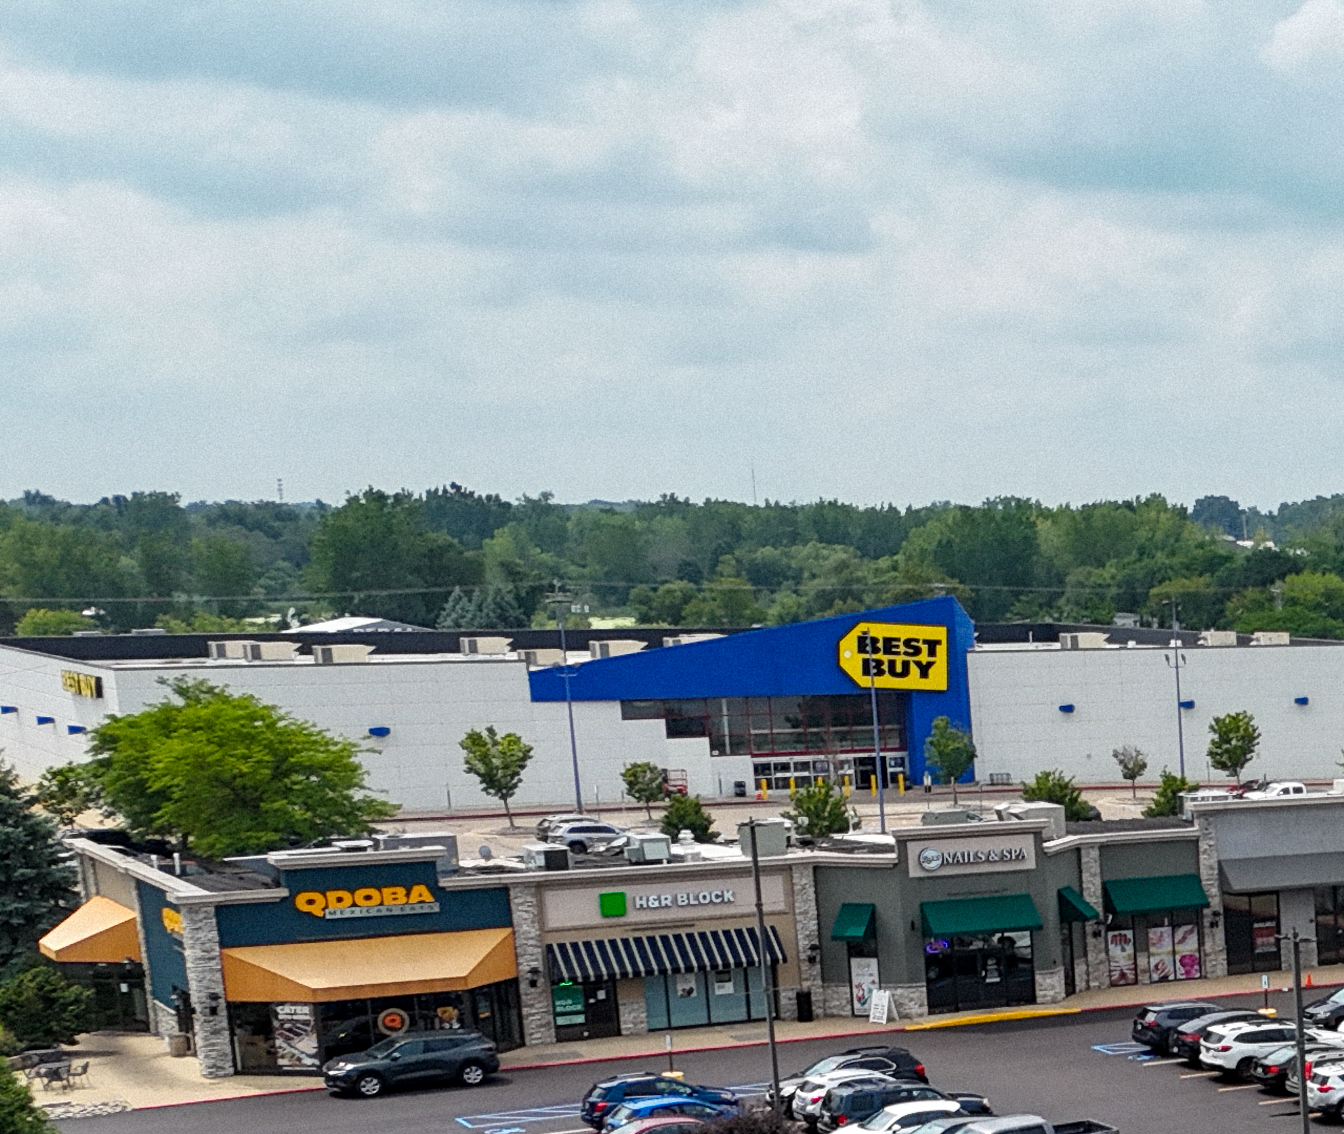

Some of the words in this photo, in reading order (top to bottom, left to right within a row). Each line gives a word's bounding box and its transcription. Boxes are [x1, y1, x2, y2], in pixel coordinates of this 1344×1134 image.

[857, 635, 942, 658] BEST
[862, 658, 936, 679] BUY
[942, 850, 985, 865] NAILS
[988, 849, 999, 862] &
[1002, 847, 1028, 861] SPA
[295, 885, 435, 917] QDOBA
[634, 895, 672, 909] H&R
[677, 890, 735, 906] BLOCK
[328, 905, 394, 916] MEXICAN
[400, 904, 436, 912] EATS
